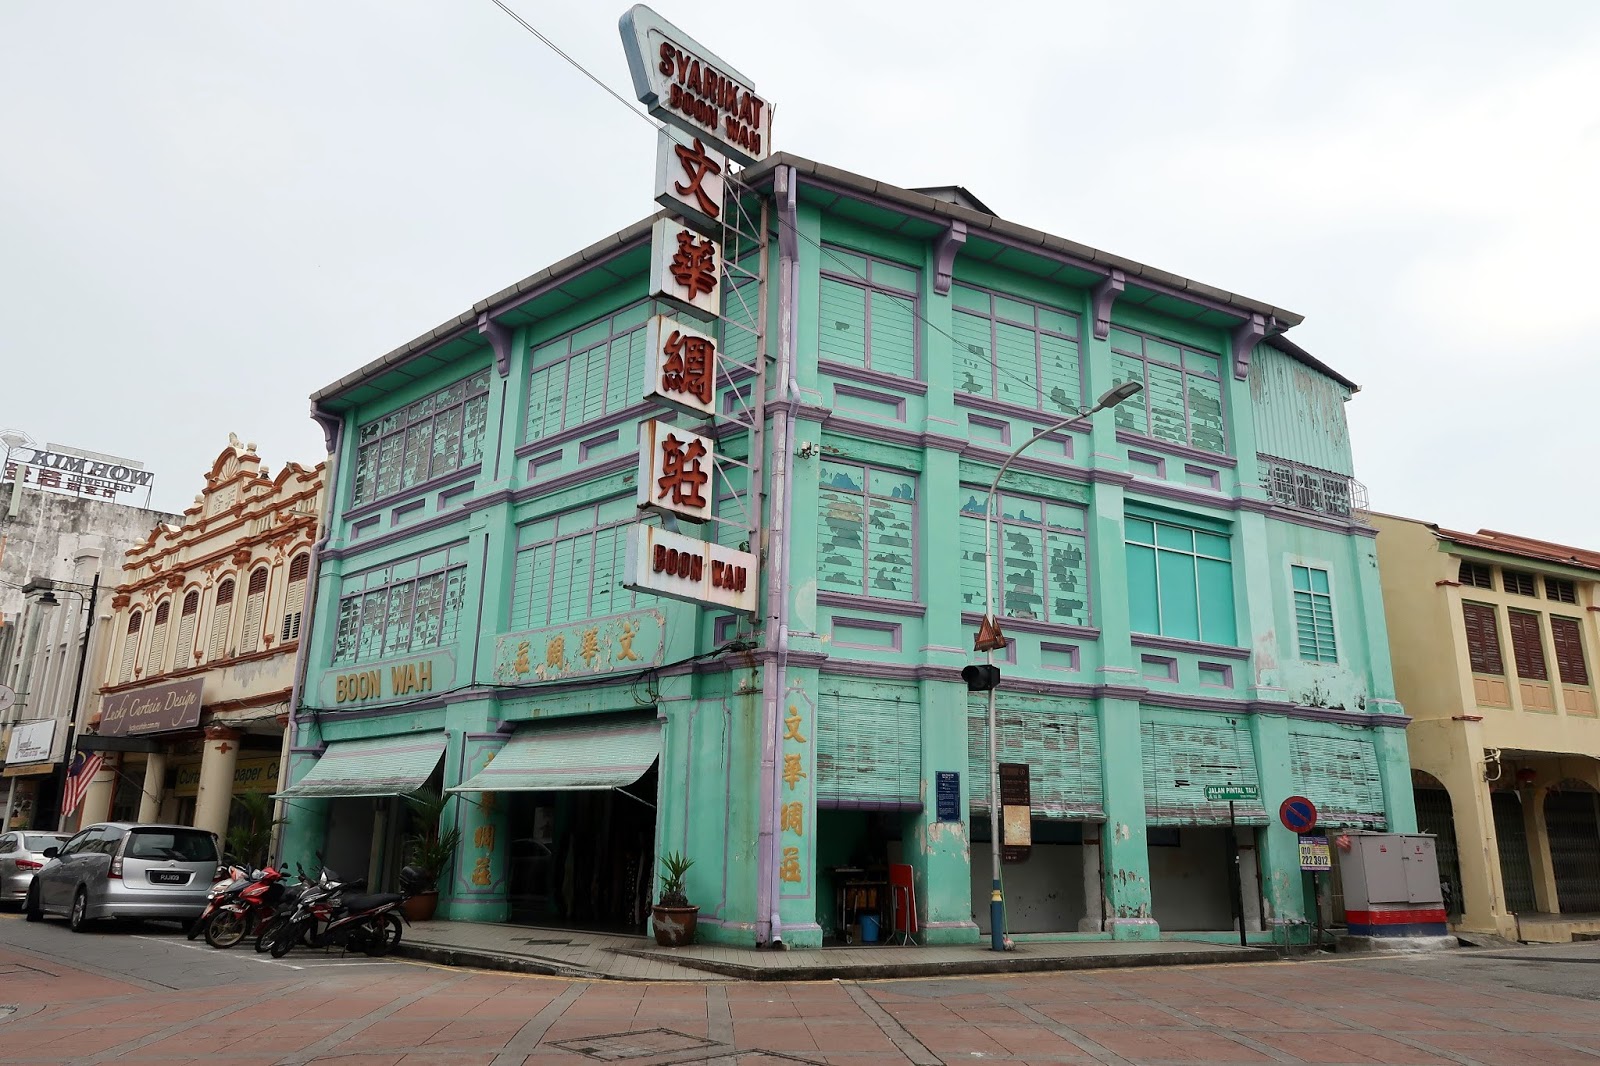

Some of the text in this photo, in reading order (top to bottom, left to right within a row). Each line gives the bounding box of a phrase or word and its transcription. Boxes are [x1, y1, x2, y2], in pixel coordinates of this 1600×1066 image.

[659, 41, 764, 130] SYARIKAT
[670, 82, 761, 156] BOON WAH
[28, 449, 155, 486] KIM HOW
[67, 474, 137, 494] JEWELLERY
[652, 543, 747, 593] BOON WAH
[335, 660, 433, 703] BOON WAH
[163, 689, 198, 727] Design
[1208, 786, 1257, 795] JALAN PINTAL TALI
[1300, 846, 1311, 855] 010
[1301, 855, 1329, 866] 222 3912
